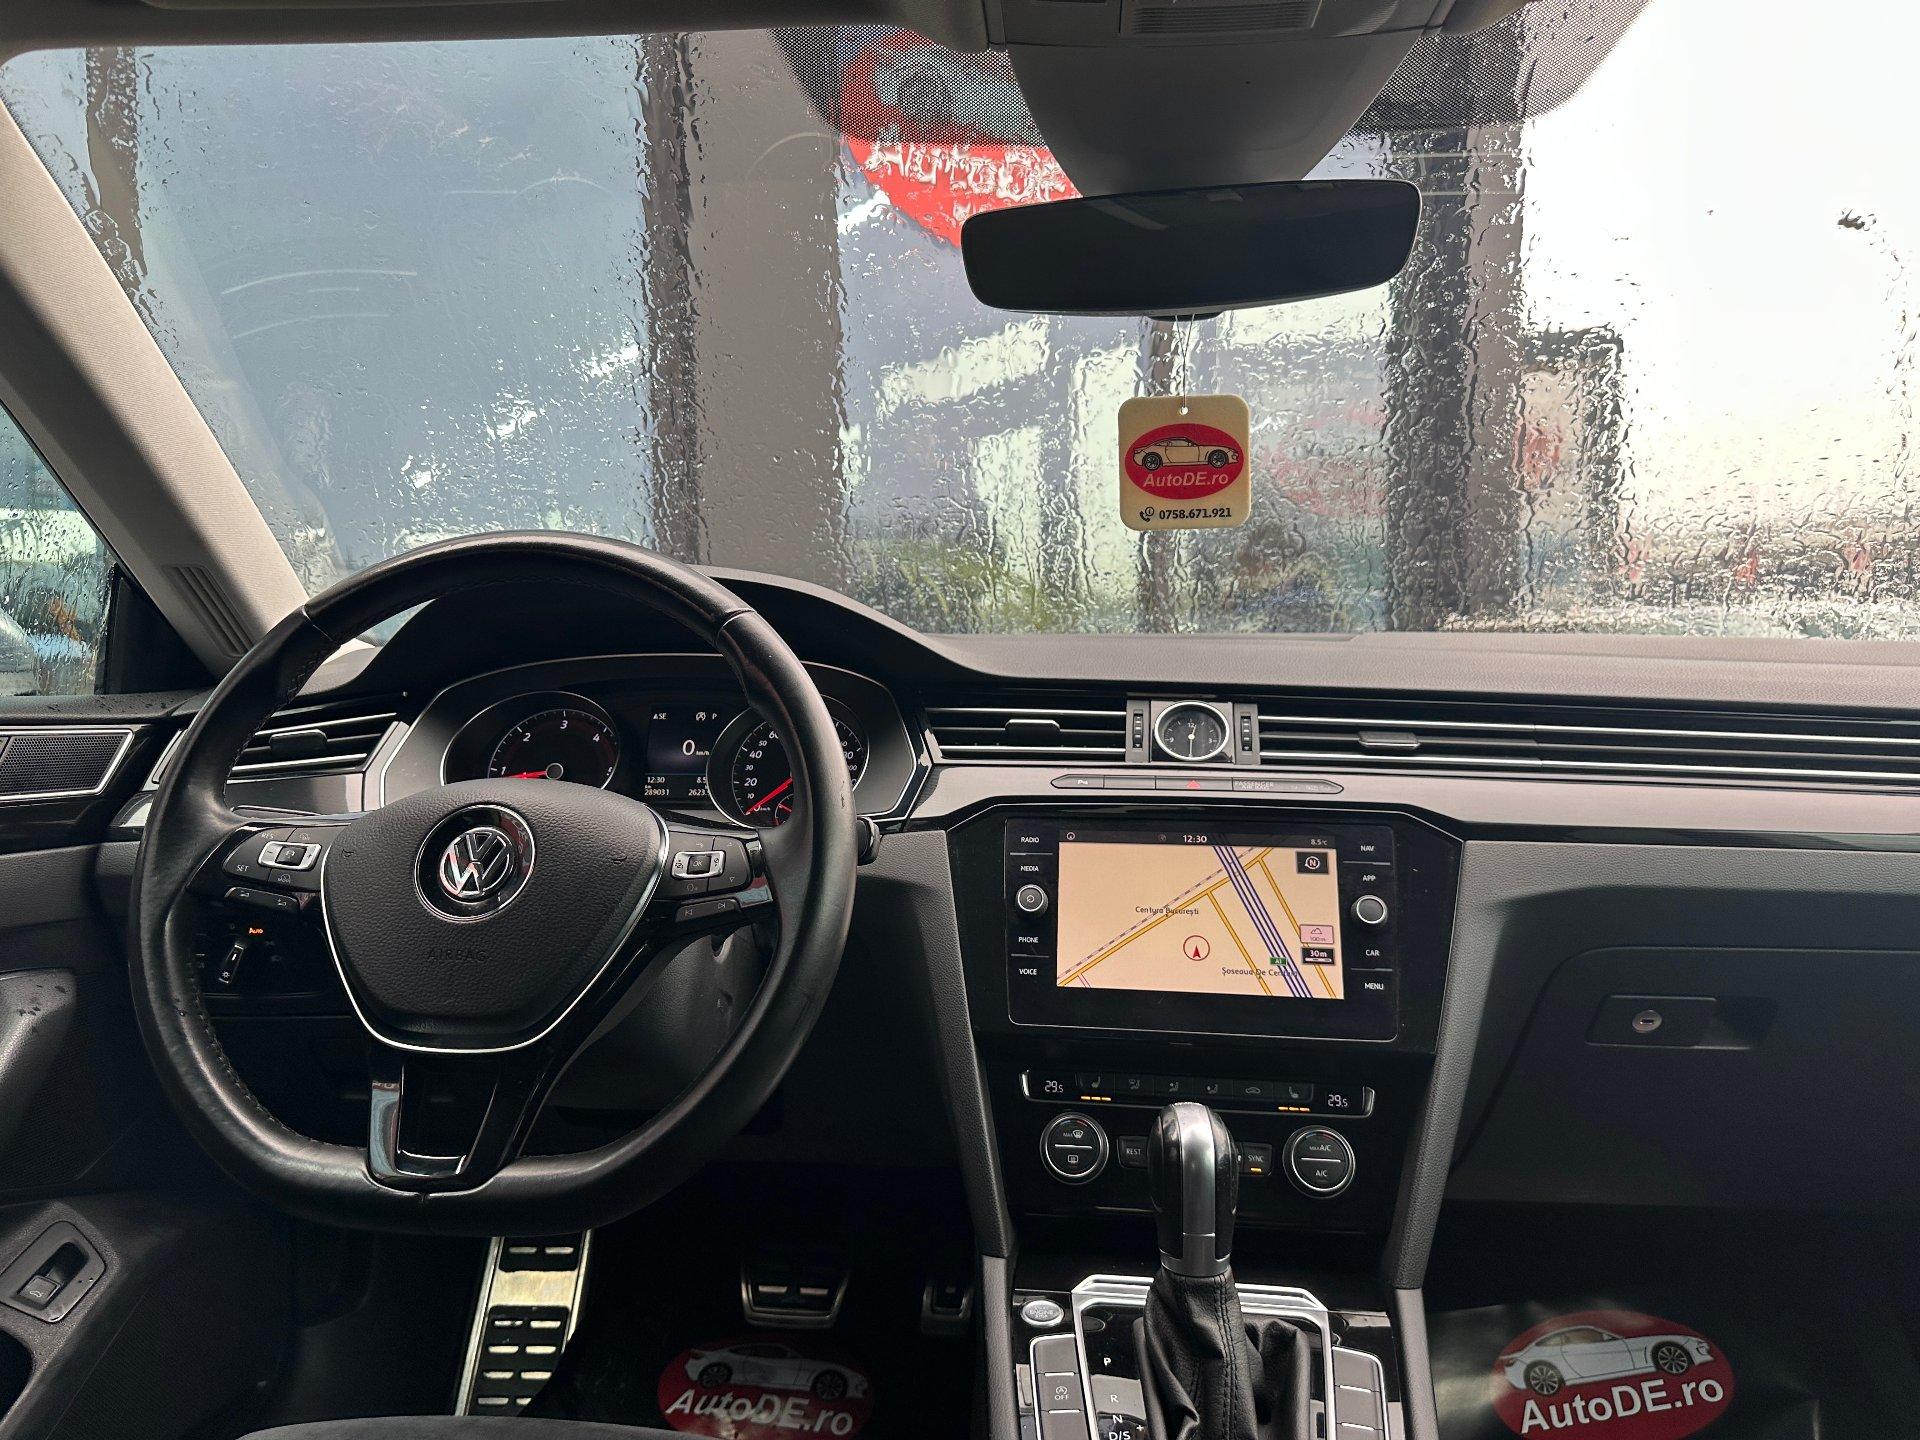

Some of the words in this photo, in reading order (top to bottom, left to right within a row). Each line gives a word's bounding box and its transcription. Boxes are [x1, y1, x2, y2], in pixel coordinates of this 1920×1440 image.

[1142, 472, 1229, 488] AutoDE.ro
[1159, 507, 1232, 520] 0758.671.921
[560, 720, 568, 729] 3
[523, 733, 531, 742] 2
[592, 733, 600, 742] 4
[682, 739, 696, 756] 0
[749, 750, 762, 759] 40
[500, 766, 507, 775] 1
[744, 777, 758, 787] 20
[644, 788, 670, 796] 289031
[1183, 834, 1208, 843] 12:30
[1309, 859, 1317, 867] N
[236, 864, 250, 873] SET
[1365, 949, 1380, 957] CAR
[1364, 982, 1385, 990] MENU
[1044, 1080, 1064, 1093] 29.5
[1327, 1094, 1348, 1107] 29.5
[1247, 1154, 1264, 1162] SYNC
[1315, 1169, 1328, 1177] A/C
[1103, 1357, 1112, 1366] P
[1110, 1394, 1119, 1403] R
[1520, 1378, 1724, 1434] AutoDE.ro
[665, 1388, 853, 1435] AutoDE.ro
[1112, 1414, 1123, 1424] N
[1108, 1430, 1131, 1440] D/S
